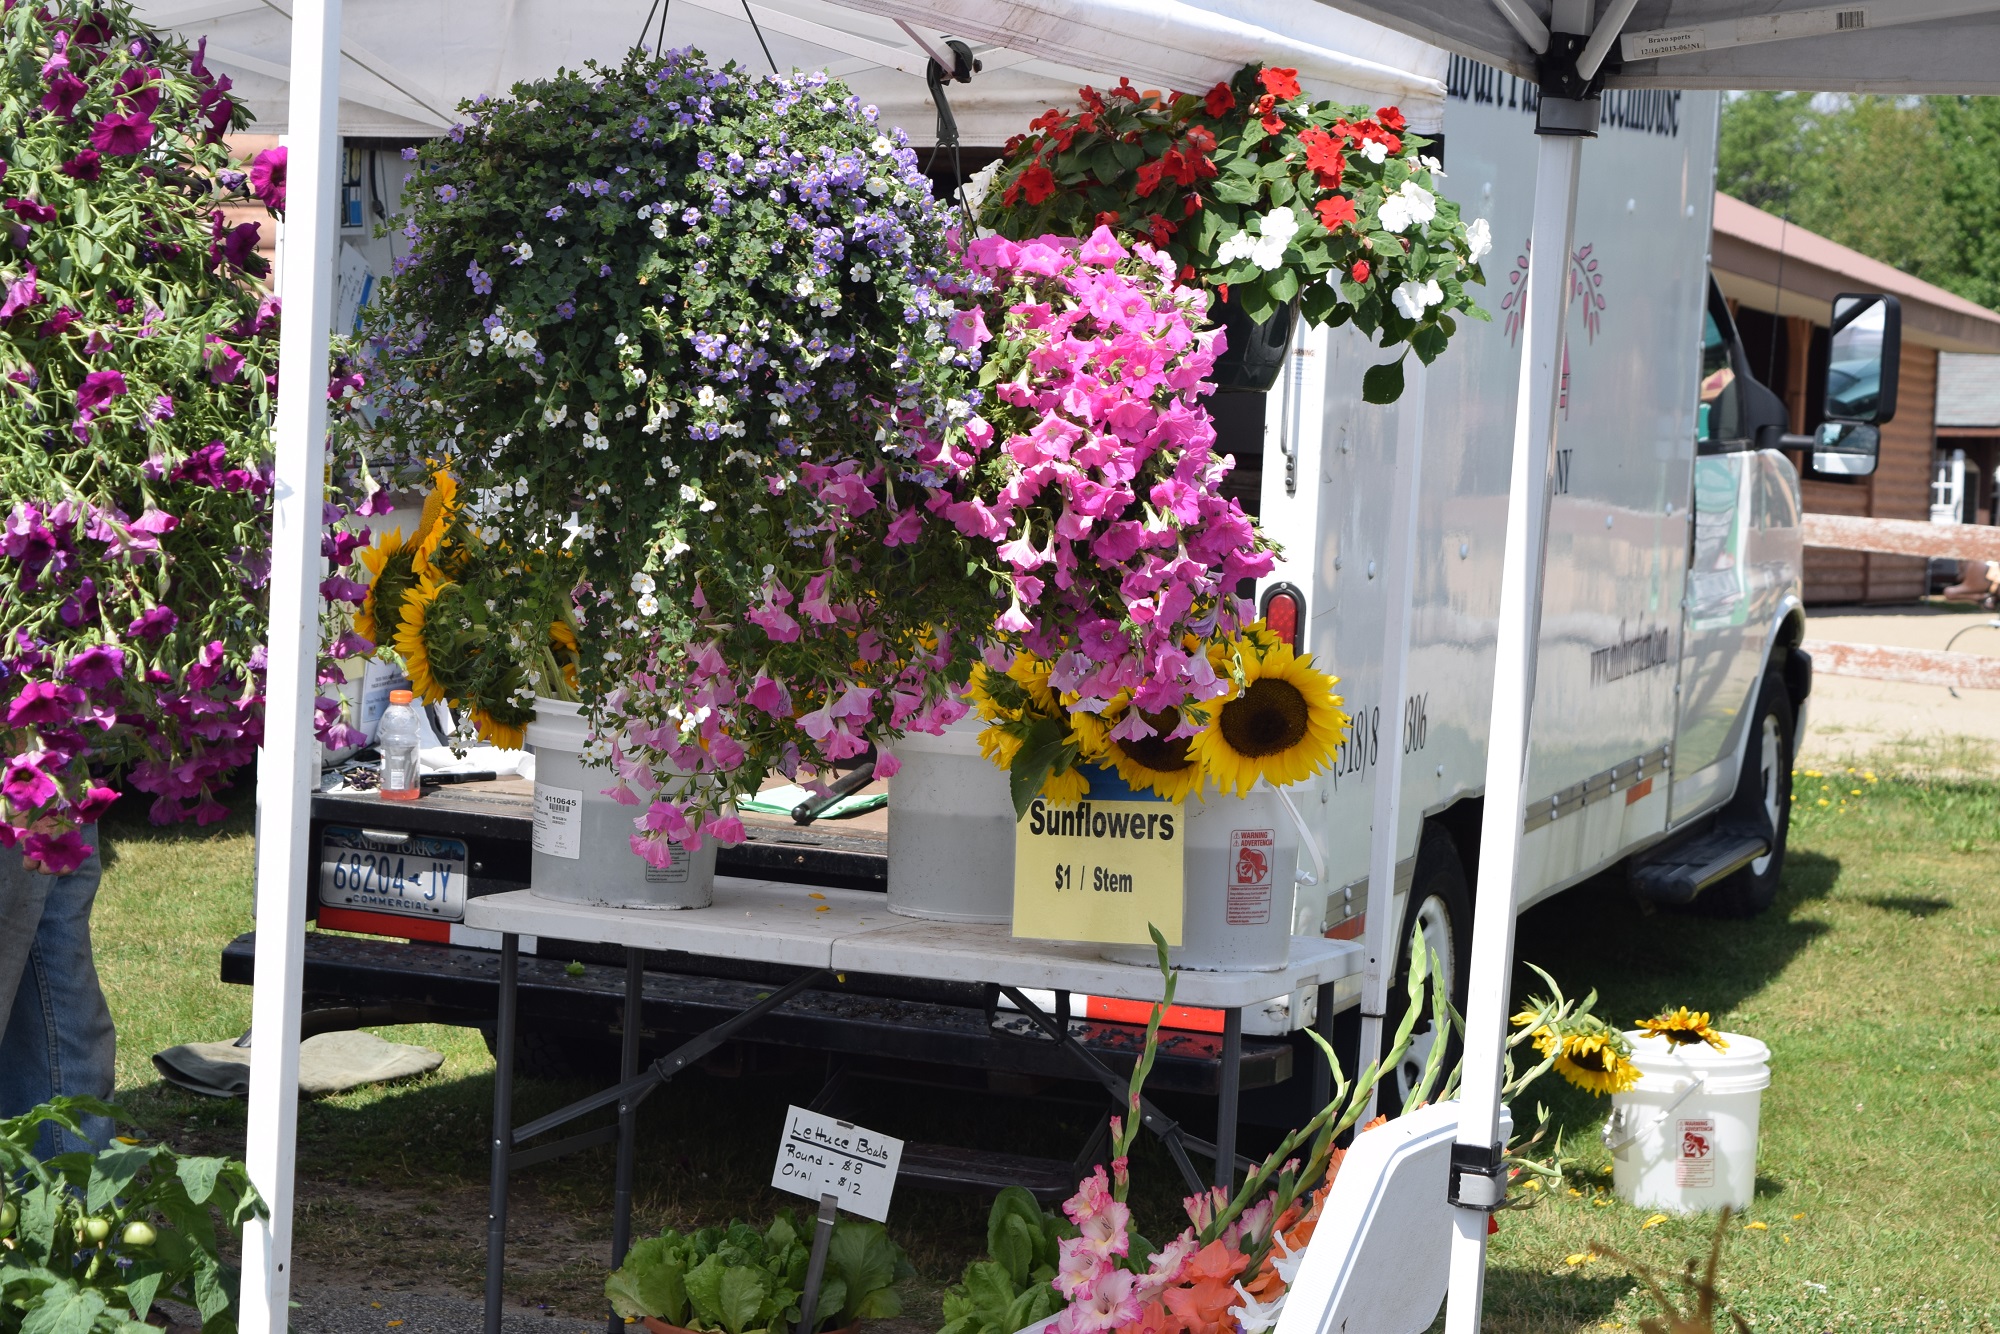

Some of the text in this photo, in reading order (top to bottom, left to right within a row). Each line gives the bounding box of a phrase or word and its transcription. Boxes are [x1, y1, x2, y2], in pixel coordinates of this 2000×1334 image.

[1648, 34, 1691, 44] Bravo sports
[545, 795, 577, 807] 4110645
[1030, 800, 1174, 840] Sunflowers
[1241, 839, 1272, 847] ADVERTENCIA
[334, 852, 453, 903] 68204 JY
[1055, 863, 1071, 892] $1
[1093, 866, 1133, 893] Stem
[353, 894, 430, 912] COMMERCIAL
[792, 1117, 888, 1160] Lettuce Bowls
[785, 1143, 823, 1166] Round
[841, 1159, 864, 1175] $8
[781, 1163, 812, 1181] Oval
[837, 1176, 862, 1196] $12
